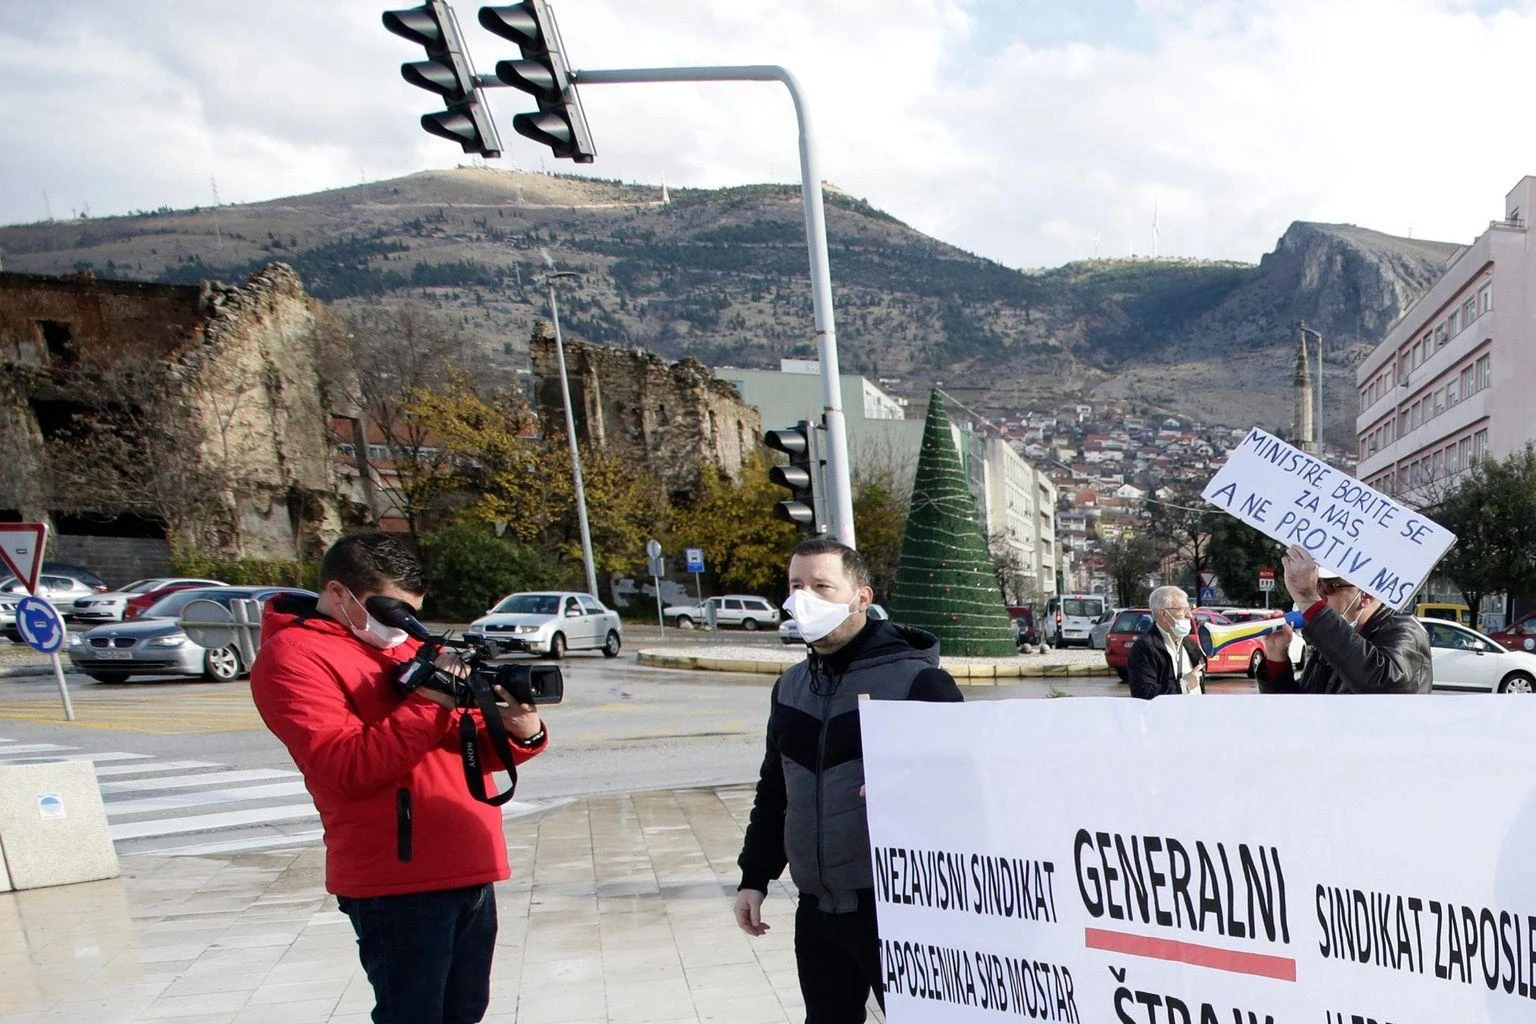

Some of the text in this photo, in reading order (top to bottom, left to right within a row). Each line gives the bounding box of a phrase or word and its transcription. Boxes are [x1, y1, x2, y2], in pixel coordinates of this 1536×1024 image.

[1294, 489, 1320, 513] ZA
[1331, 479, 1399, 528] BORITE
[1400, 518, 1434, 545] SE
[1211, 482, 1415, 605] A NE PROTIV NAS
[466, 741, 477, 769] SONY
[875, 847, 1057, 923] NEZAVISNI SINDIKAT
[1074, 828, 1290, 944] GENERALNI
[1316, 883, 1424, 974] SINDIKAT
[975, 951, 1008, 1012] SKB
[1005, 956, 1081, 1024] MOSTAR
